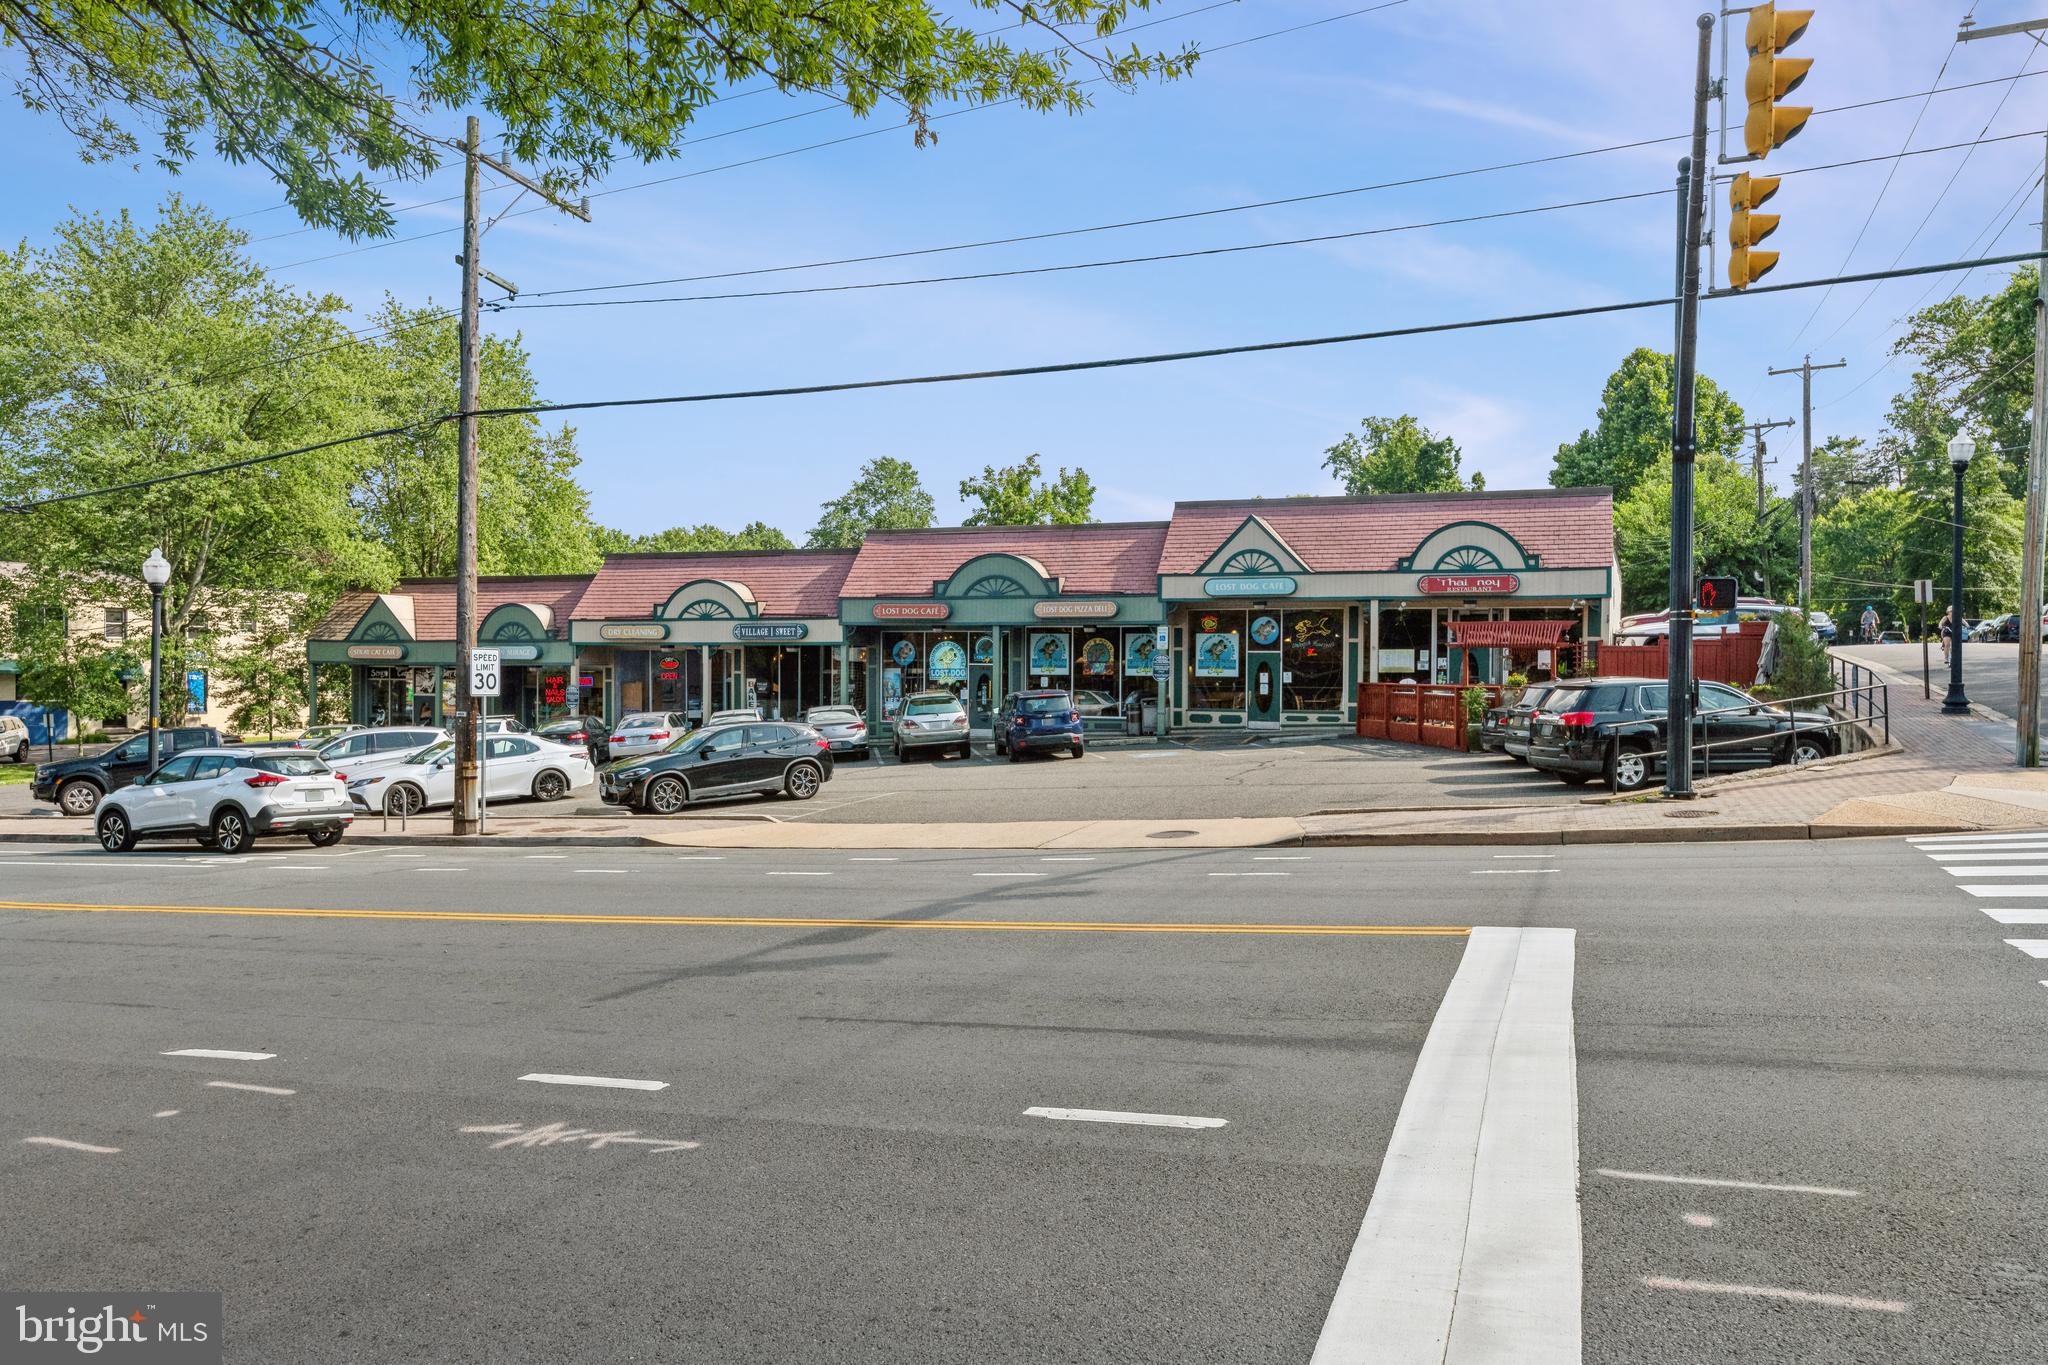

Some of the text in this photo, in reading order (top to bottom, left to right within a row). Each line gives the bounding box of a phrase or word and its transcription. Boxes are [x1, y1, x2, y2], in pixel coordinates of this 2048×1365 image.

[1215, 583, 1237, 591] LOST
[1240, 583, 1259, 591] DOG
[1477, 578, 1500, 588] noy
[882, 607, 900, 615] LOST
[902, 607, 919, 615] DOG
[1074, 605, 1093, 613] PIZZA
[608, 628, 658, 636] DRY CLEANING
[741, 627, 796, 636] VILLAGE SWEET
[473, 653, 498, 662] SPEED
[475, 663, 495, 671] LIMIT
[661, 671, 679, 680] OPEN
[930, 669, 966, 677] LOST DOG
[474, 672, 497, 690] 30
[545, 675, 564, 685] HAIR
[545, 688, 566, 696] NAILS
